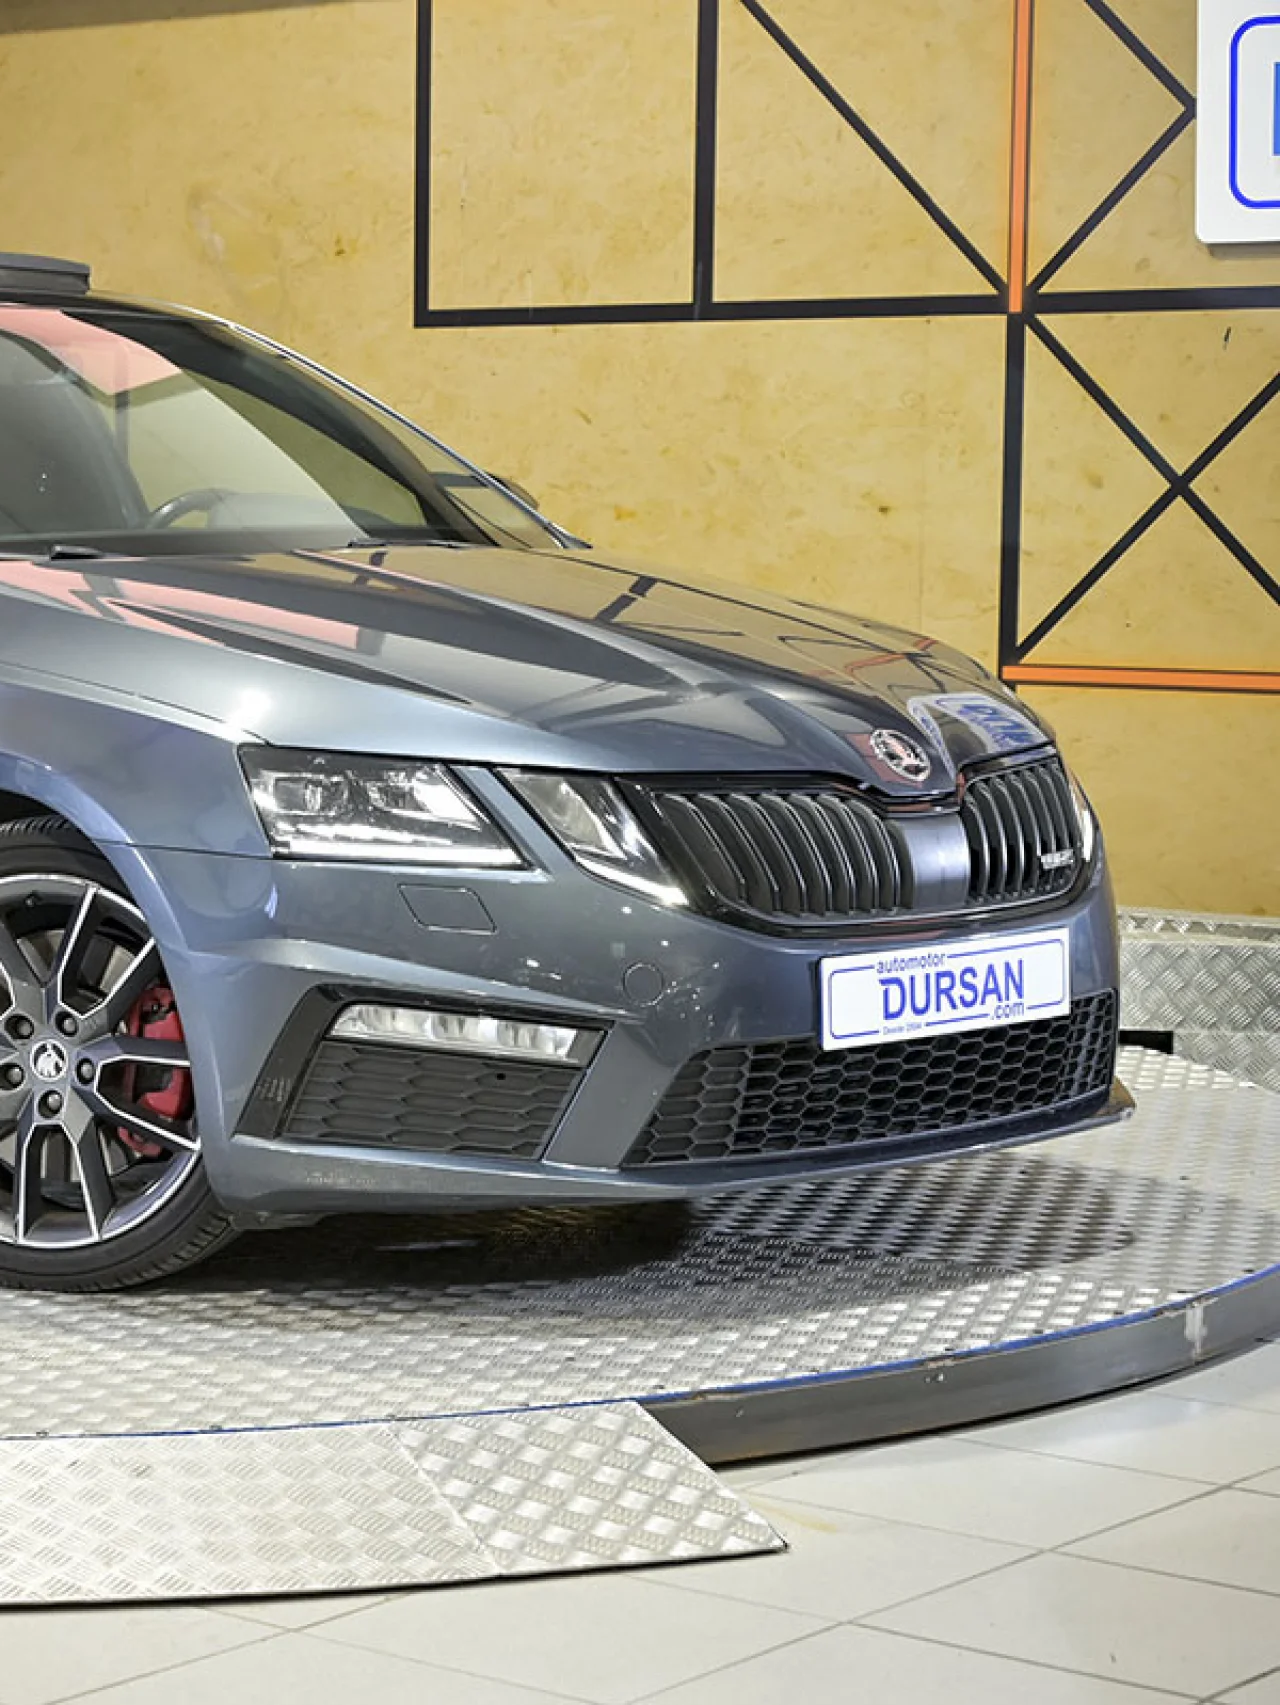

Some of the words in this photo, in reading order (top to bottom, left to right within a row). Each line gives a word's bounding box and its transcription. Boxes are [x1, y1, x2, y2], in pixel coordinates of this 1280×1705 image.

[876, 952, 946, 974] automotor
[878, 959, 1024, 1020] DURSAN
[991, 1002, 1024, 1020] .com
